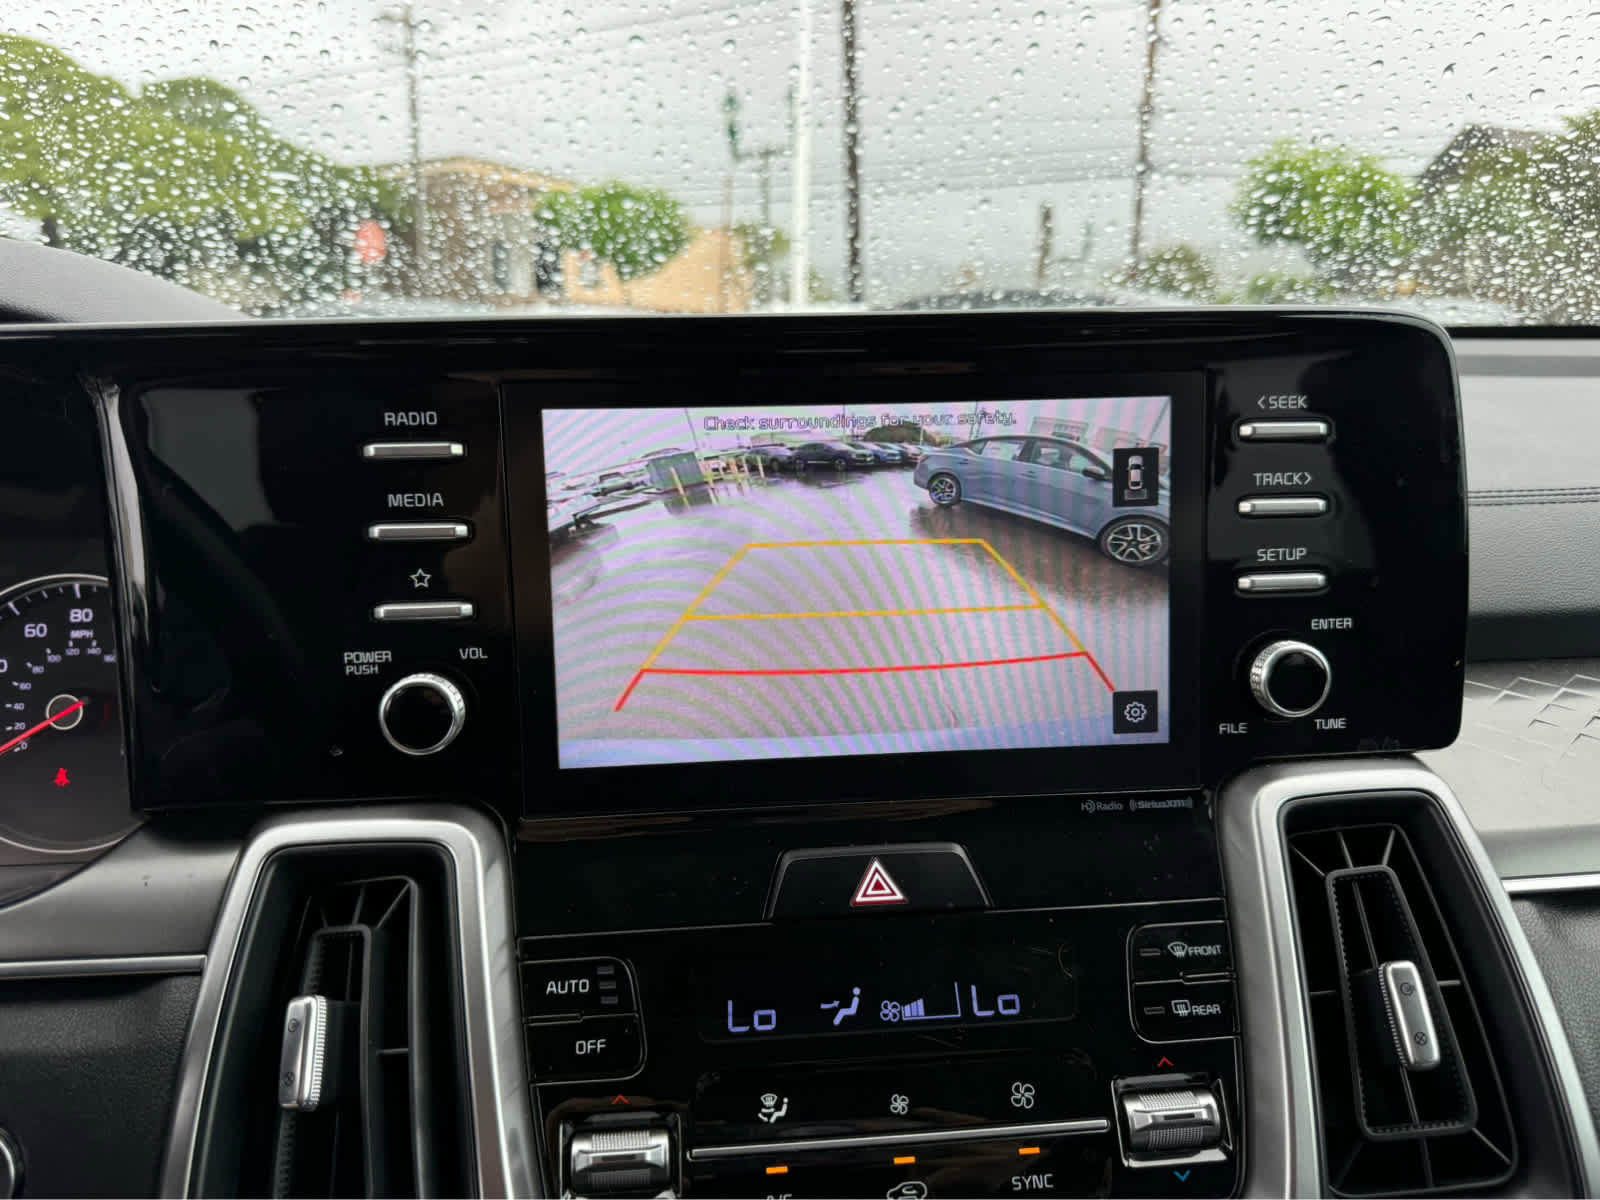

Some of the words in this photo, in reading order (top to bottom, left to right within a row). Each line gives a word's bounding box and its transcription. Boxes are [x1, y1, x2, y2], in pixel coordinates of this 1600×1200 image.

[1269, 395, 1308, 409] SEEK
[384, 411, 437, 426] RADIO
[704, 416, 754, 430] Check
[758, 413, 877, 430] surroundings
[880, 412, 907, 426] for
[912, 412, 954, 427] your
[957, 408, 1017, 427] safety.
[387, 493, 444, 507] MEDIA
[1256, 547, 1307, 562] SETUP
[69, 608, 93, 623] 80
[1311, 617, 1352, 630] ENTER
[24, 624, 48, 638] 60
[70, 629, 93, 640] MPH
[344, 651, 392, 664] POWER
[459, 648, 488, 660] VOL
[32, 665, 44, 674] 80
[345, 664, 379, 675] PUSH
[19, 682, 32, 691] 60
[13, 701, 25, 711] 40
[14, 721, 26, 731] 20
[1219, 723, 1248, 734] FILE
[1315, 718, 1347, 730] TUNE
[1096, 801, 1124, 812] Radio
[1188, 944, 1222, 957] FRONT
[546, 978, 590, 995] AUTO
[971, 985, 1020, 1016] Lo
[728, 1000, 776, 1032] Lo
[1191, 1004, 1221, 1016] REAR
[575, 1039, 606, 1055] OFF
[1011, 1173, 1054, 1191] SYNC
